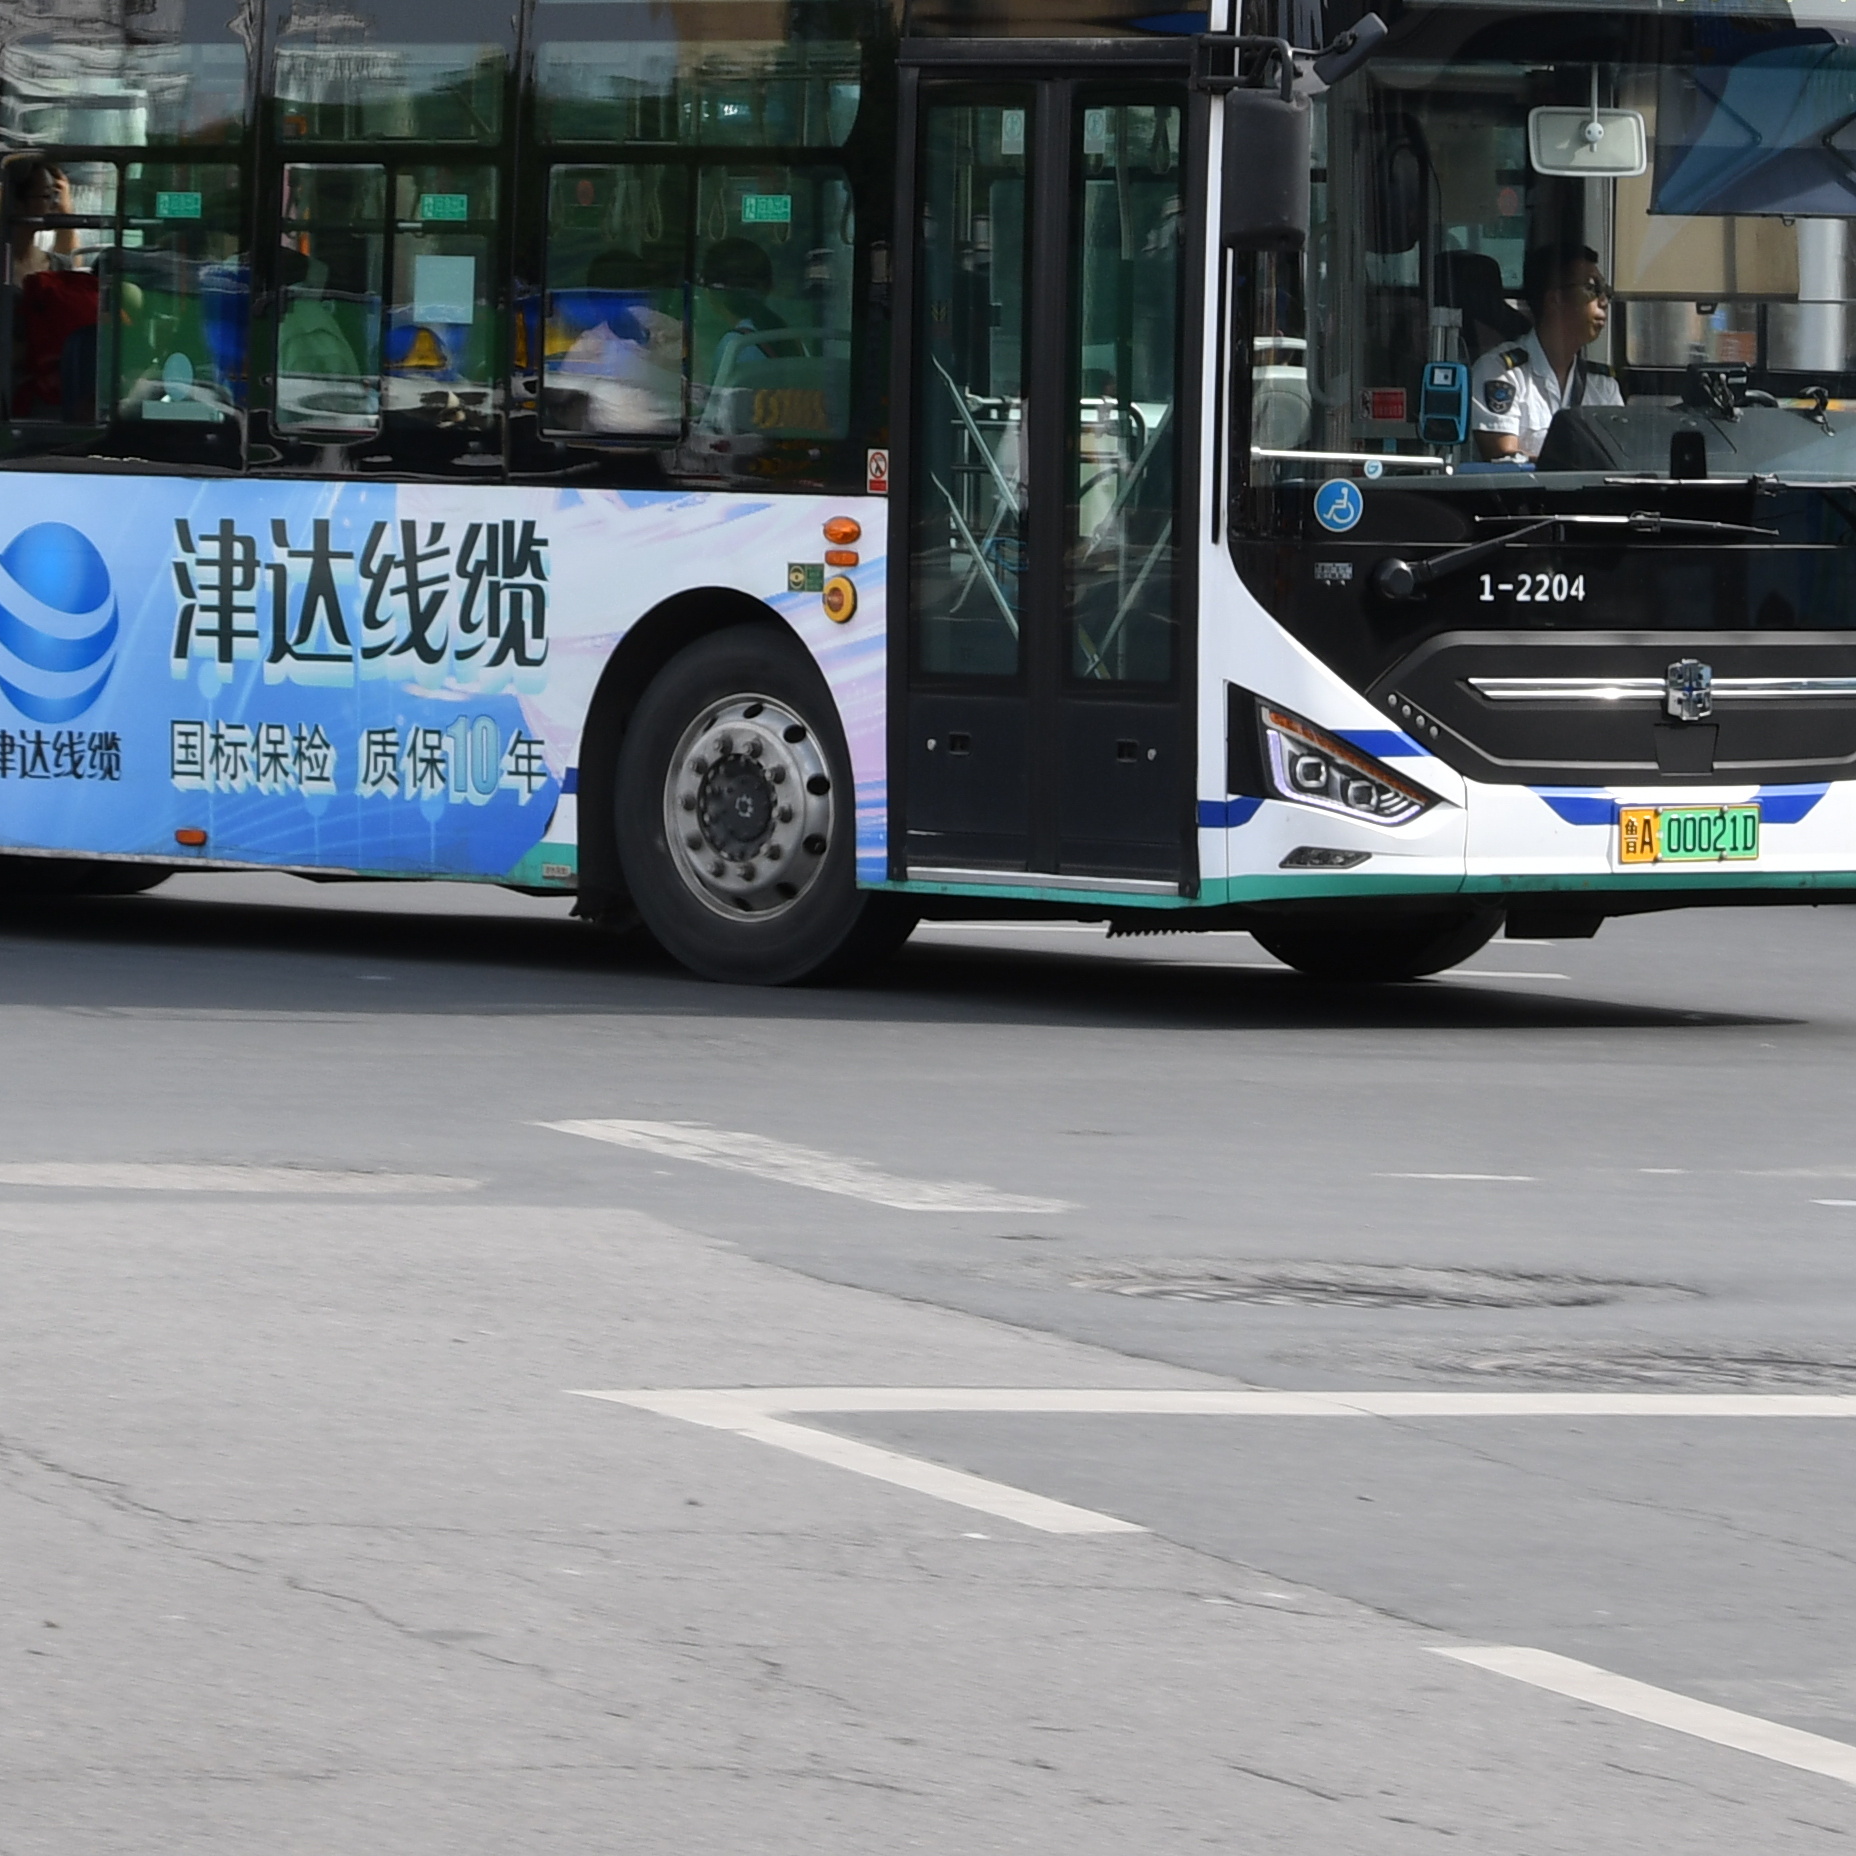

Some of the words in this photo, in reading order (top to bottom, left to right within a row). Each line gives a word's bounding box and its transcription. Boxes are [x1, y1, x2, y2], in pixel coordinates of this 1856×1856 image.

[170, 517, 550, 668] 津达线缆
[1479, 573, 1585, 602] 1-2204
[170, 719, 332, 786] 国标保检
